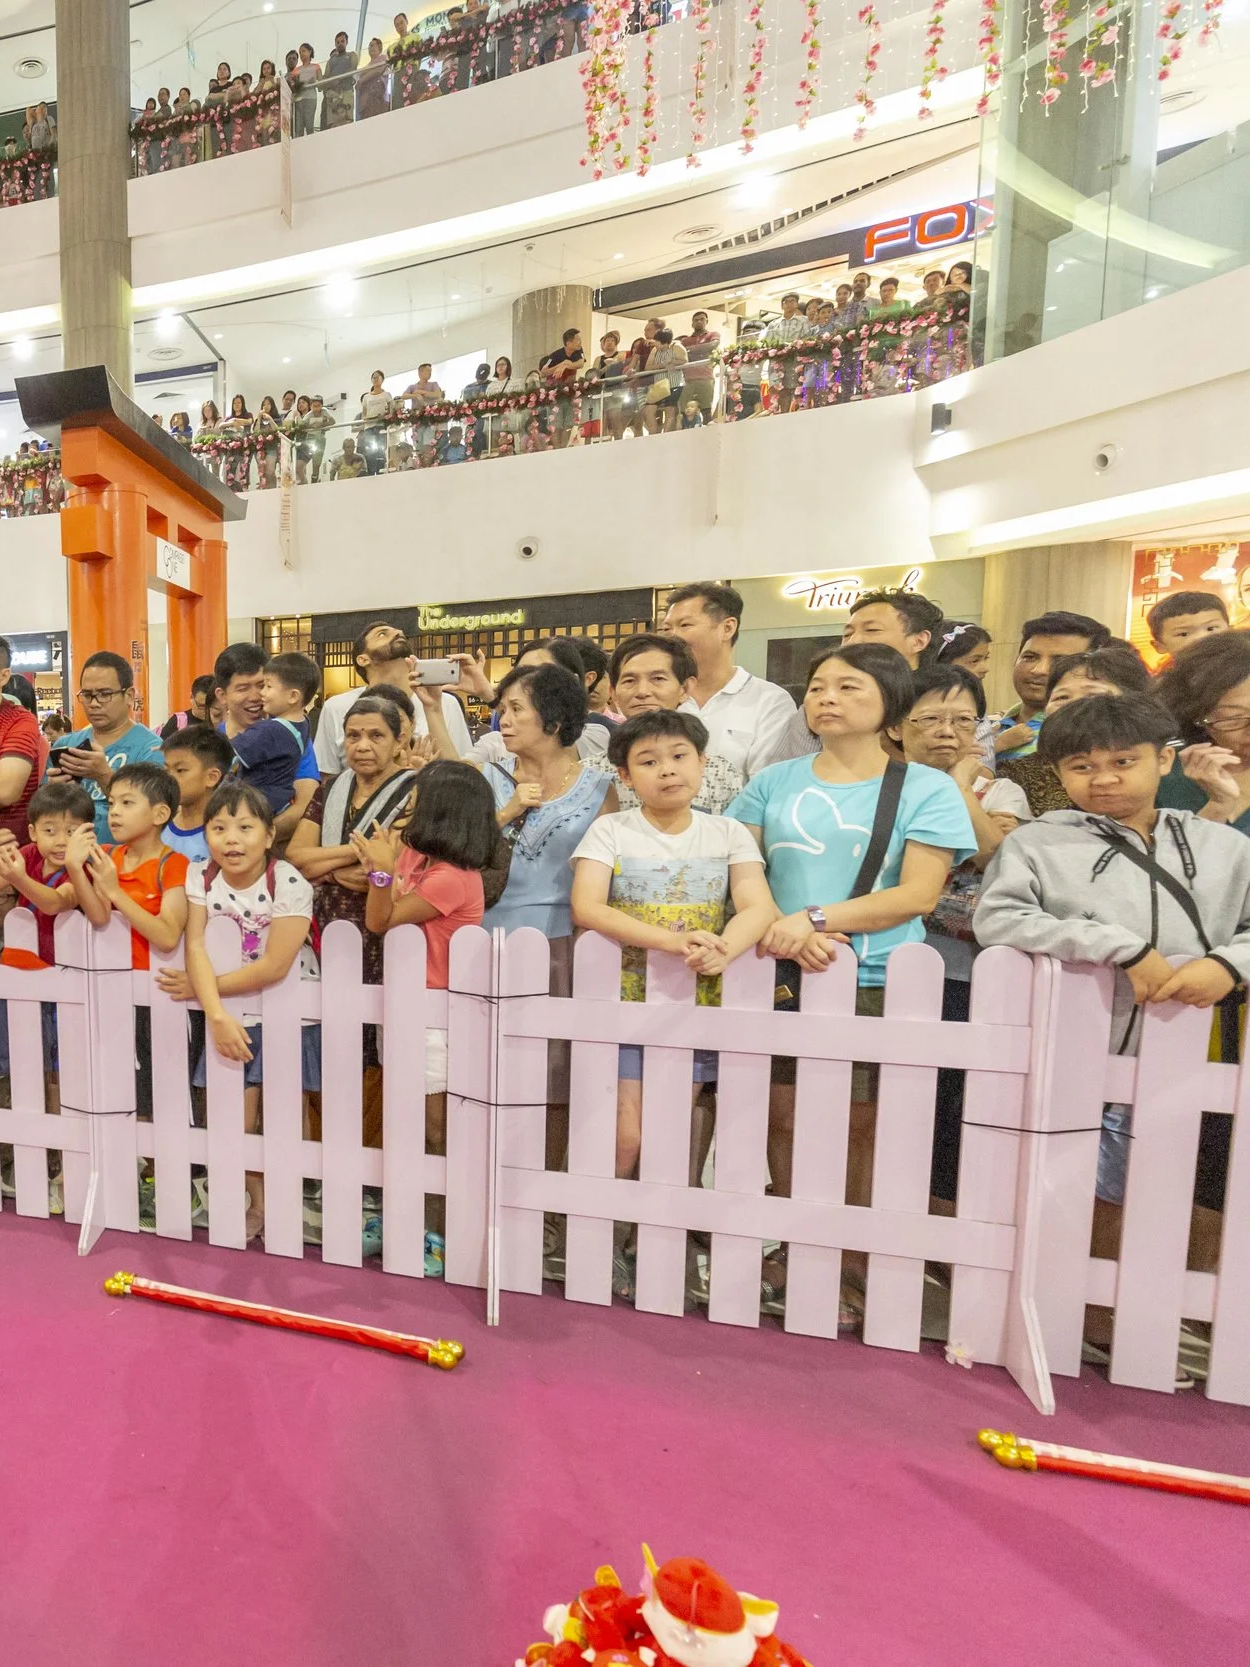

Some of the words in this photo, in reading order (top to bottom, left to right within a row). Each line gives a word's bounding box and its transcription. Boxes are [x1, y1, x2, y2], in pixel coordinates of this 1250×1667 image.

[785, 569, 920, 608] Triuh
[418, 606, 442, 617] The
[418, 609, 524, 631] Underground
